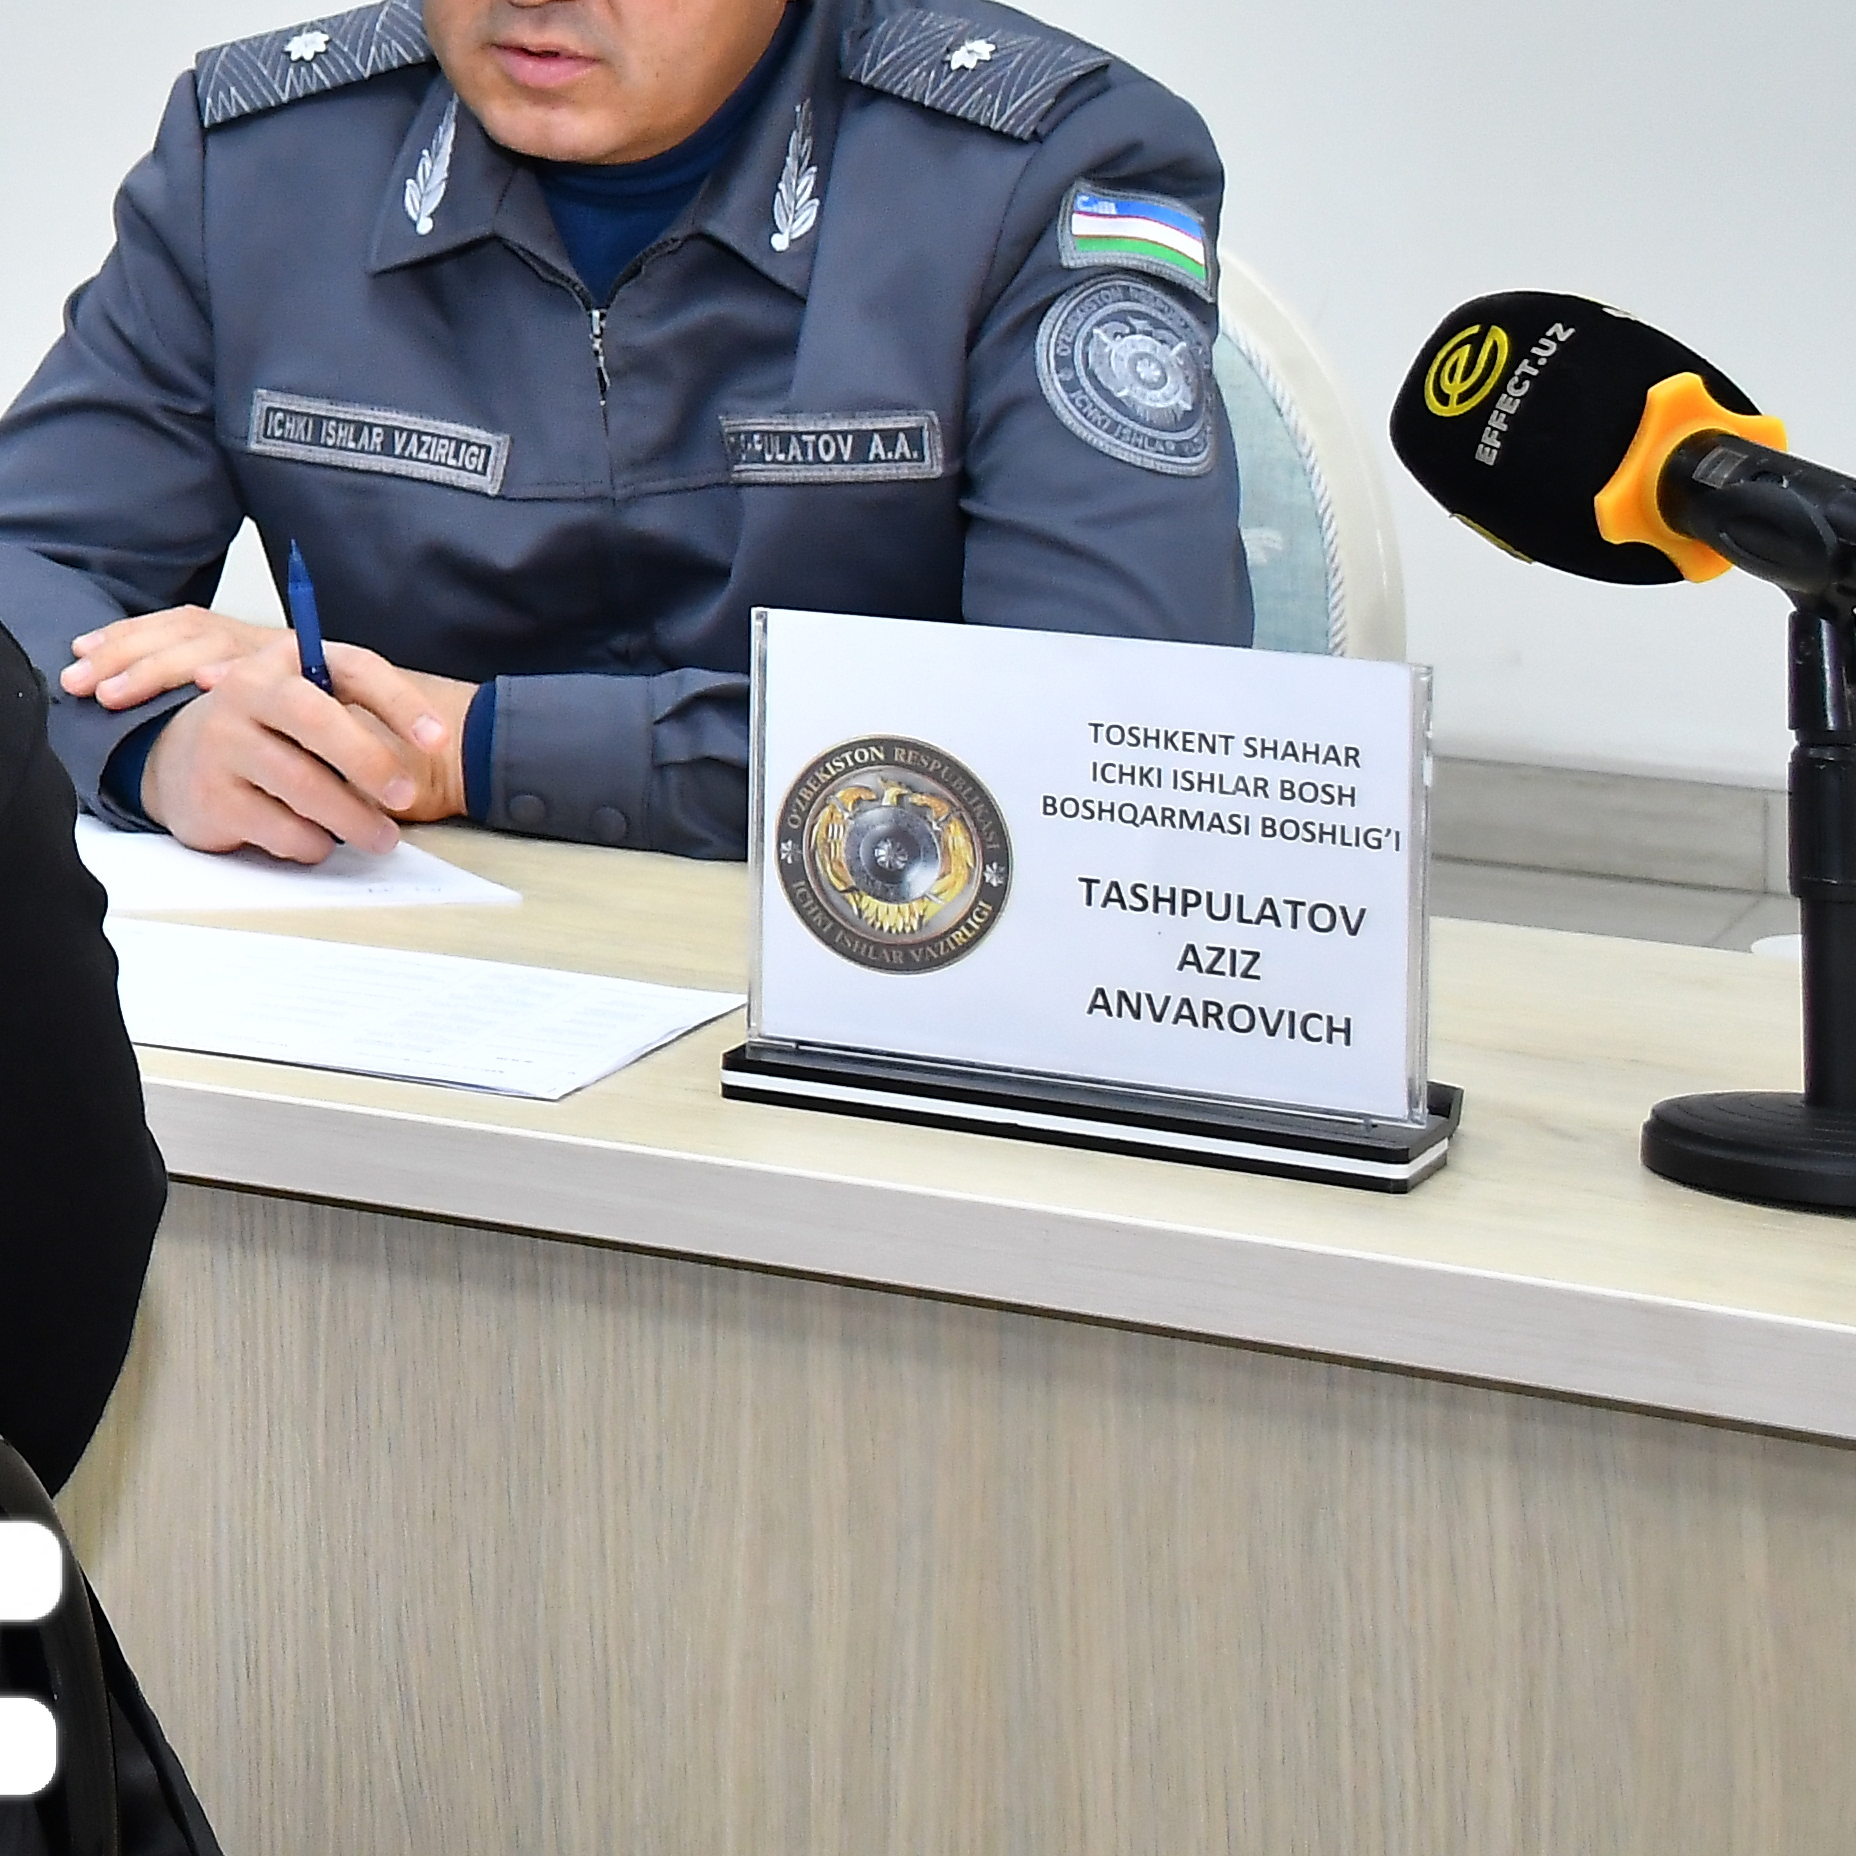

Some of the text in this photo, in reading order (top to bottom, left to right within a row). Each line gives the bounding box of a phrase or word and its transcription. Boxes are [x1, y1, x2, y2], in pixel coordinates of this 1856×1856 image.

[1475, 322, 1576, 466] EFFECT.UZ
[266, 411, 487, 473] ICHKI ISHLAR VAZIRLIGI
[868, 431, 919, 462] A.A.
[1088, 722, 1361, 769] TOSHKENT SHAHAR
[788, 746, 1001, 850] O'ZBEKISTON RESPUBLIKASI
[1091, 761, 1357, 808] ICHKI ISHLAR BOSH
[1042, 795, 1401, 852] BOSHQARMASI BOSHLIG'I
[791, 880, 994, 964] ICHKI ISHLAR VAZIRLIGI
[1078, 876, 1367, 937] TASHPULATOV
[1176, 943, 1262, 981] AZIZ
[1086, 987, 1353, 1047] ANVAROVICH
